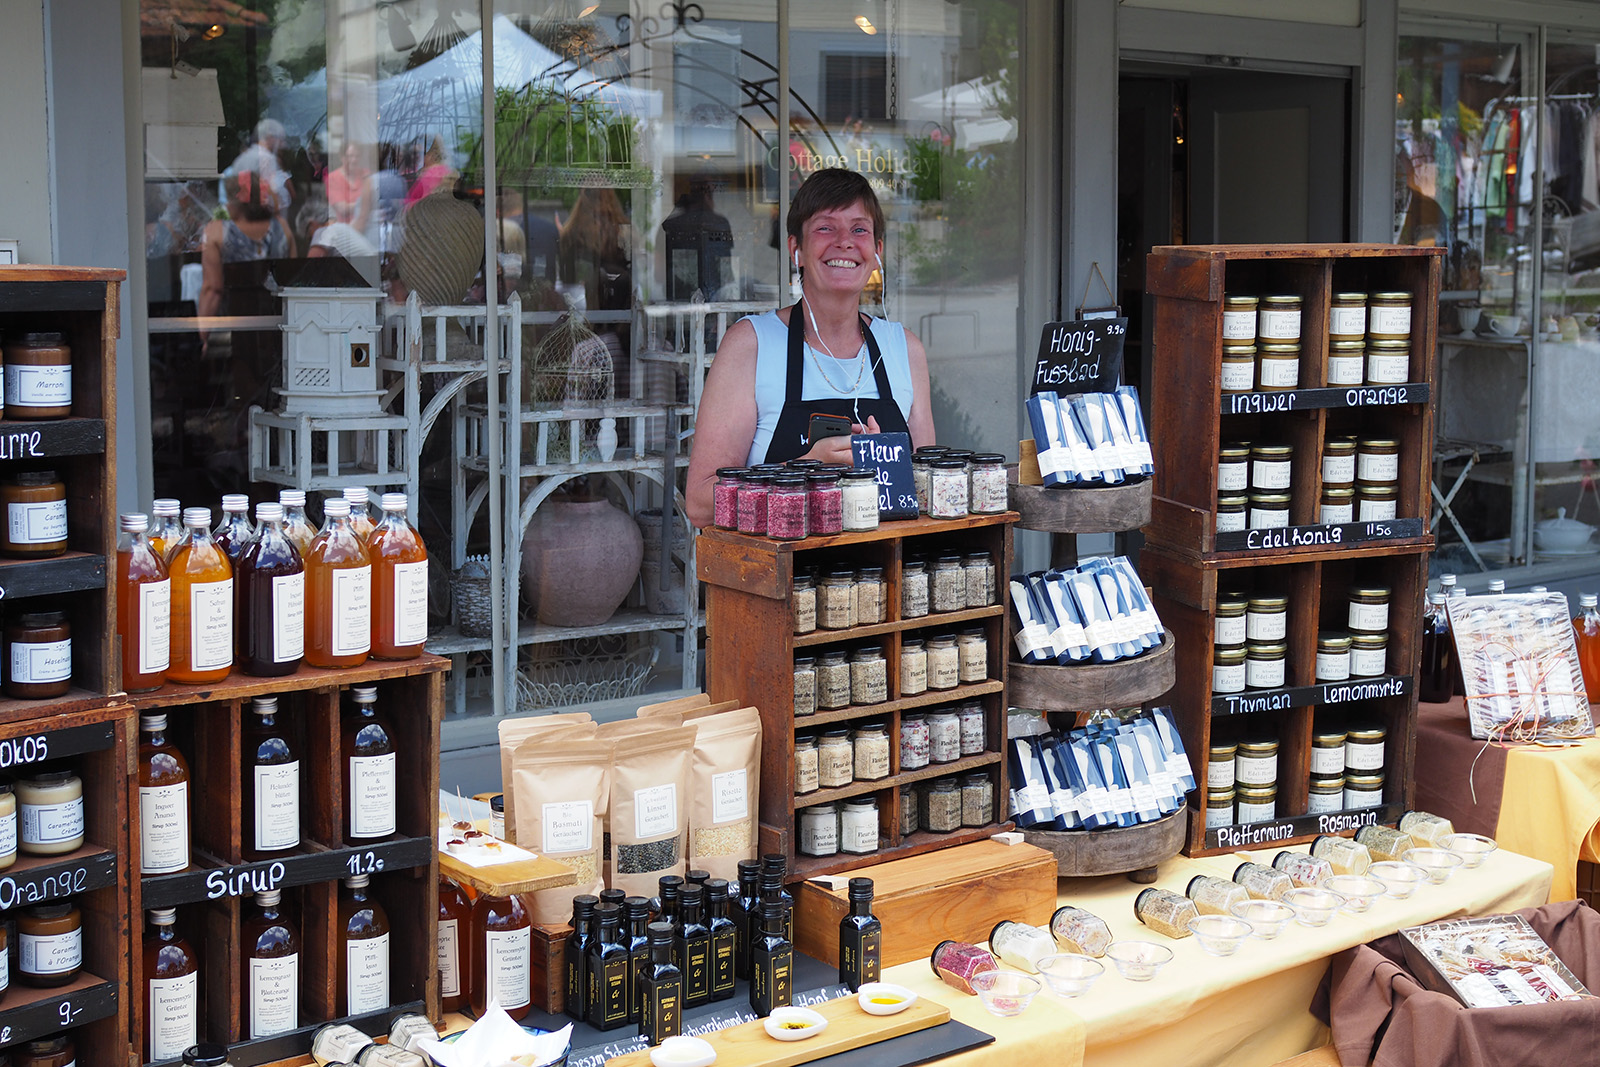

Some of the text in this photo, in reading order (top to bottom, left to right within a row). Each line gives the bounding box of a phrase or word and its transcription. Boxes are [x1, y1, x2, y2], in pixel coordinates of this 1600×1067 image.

[856, 148, 936, 179] Holiday
[1050, 323, 1101, 356] Honig-
[1036, 354, 1100, 385] Fussbad
[1231, 393, 1296, 414] Ingwer
[853, 440, 903, 463] Fleur
[878, 489, 893, 510] el
[1323, 678, 1403, 704] Lemonmyrte
[1225, 693, 1292, 715] Thymian
[552, 820, 583, 829] Basmati
[1319, 809, 1378, 833] Rosmarin
[1217, 821, 1294, 848] Pfefferminz
[0, 867, 87, 910] Orange
[206, 862, 286, 899] Sirup
[59, 1001, 83, 1025] 9.-
